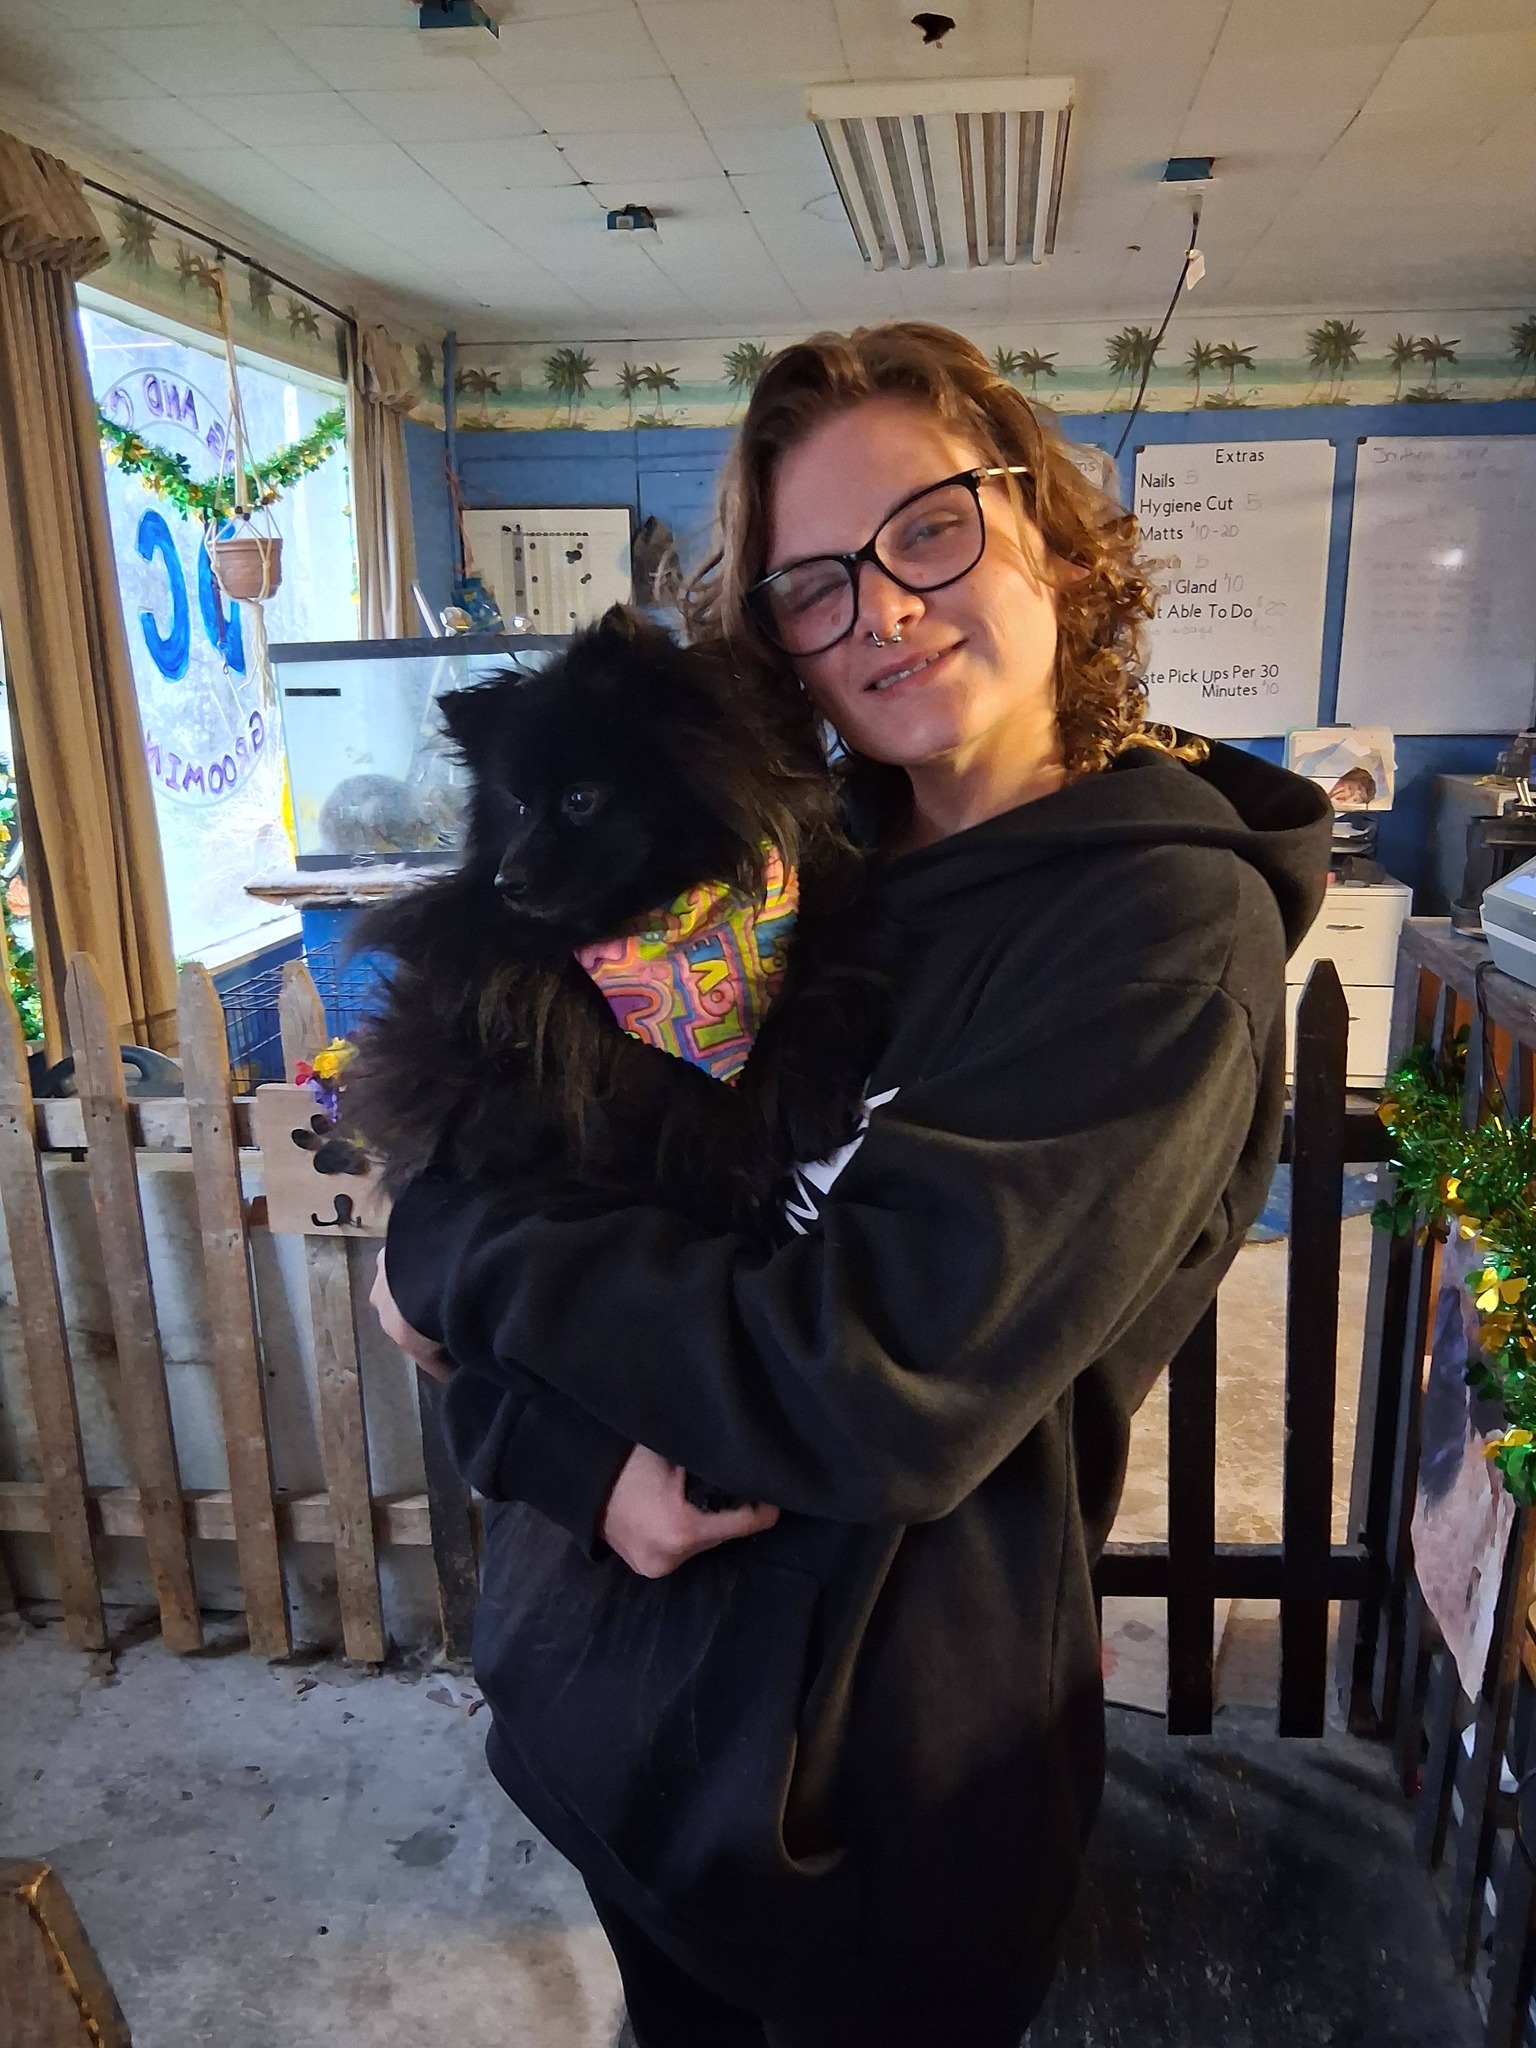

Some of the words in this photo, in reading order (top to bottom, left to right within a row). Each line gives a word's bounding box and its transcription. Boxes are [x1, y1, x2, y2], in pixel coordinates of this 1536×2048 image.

[1215, 448, 1265, 464] Extras
[1140, 473, 1176, 489] Nails
[1139, 498, 1202, 517] Hygiene
[1206, 495, 1234, 511] Cut
[1139, 526, 1184, 541] Matts
[1175, 579, 1217, 594] Gland
[1167, 603, 1202, 618] Able
[1208, 603, 1227, 618] To
[1231, 603, 1253, 618] Do
[1142, 673, 1165, 684] ate
[1168, 668, 1198, 683] Pick
[1202, 669, 1229, 684] Ups
[1232, 665, 1256, 679] Per
[1260, 664, 1279, 678] 30
[1202, 684, 1258, 698] Minutes
[685, 934, 745, 1050] LOVE
